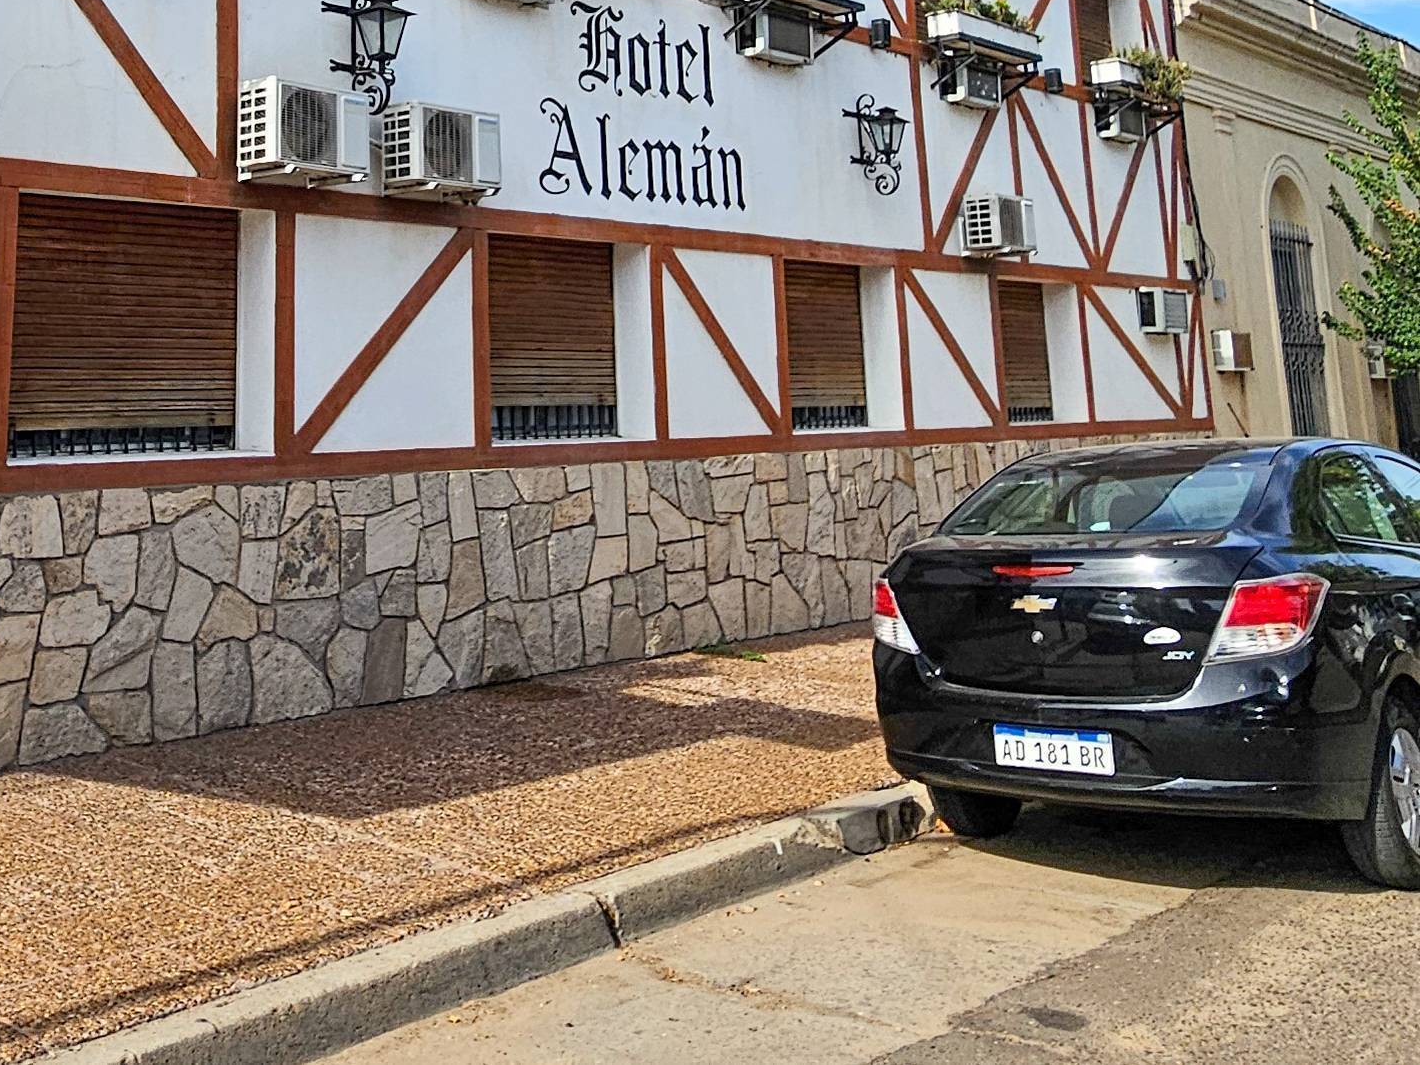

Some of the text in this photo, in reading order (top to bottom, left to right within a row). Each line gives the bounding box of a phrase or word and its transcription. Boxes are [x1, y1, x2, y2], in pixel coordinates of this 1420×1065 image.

[570, 0, 715, 108] Hotel
[539, 97, 746, 212] Alemán
[1162, 650, 1195, 661] JOY
[1003, 739, 1105, 769] AD 181 BR
